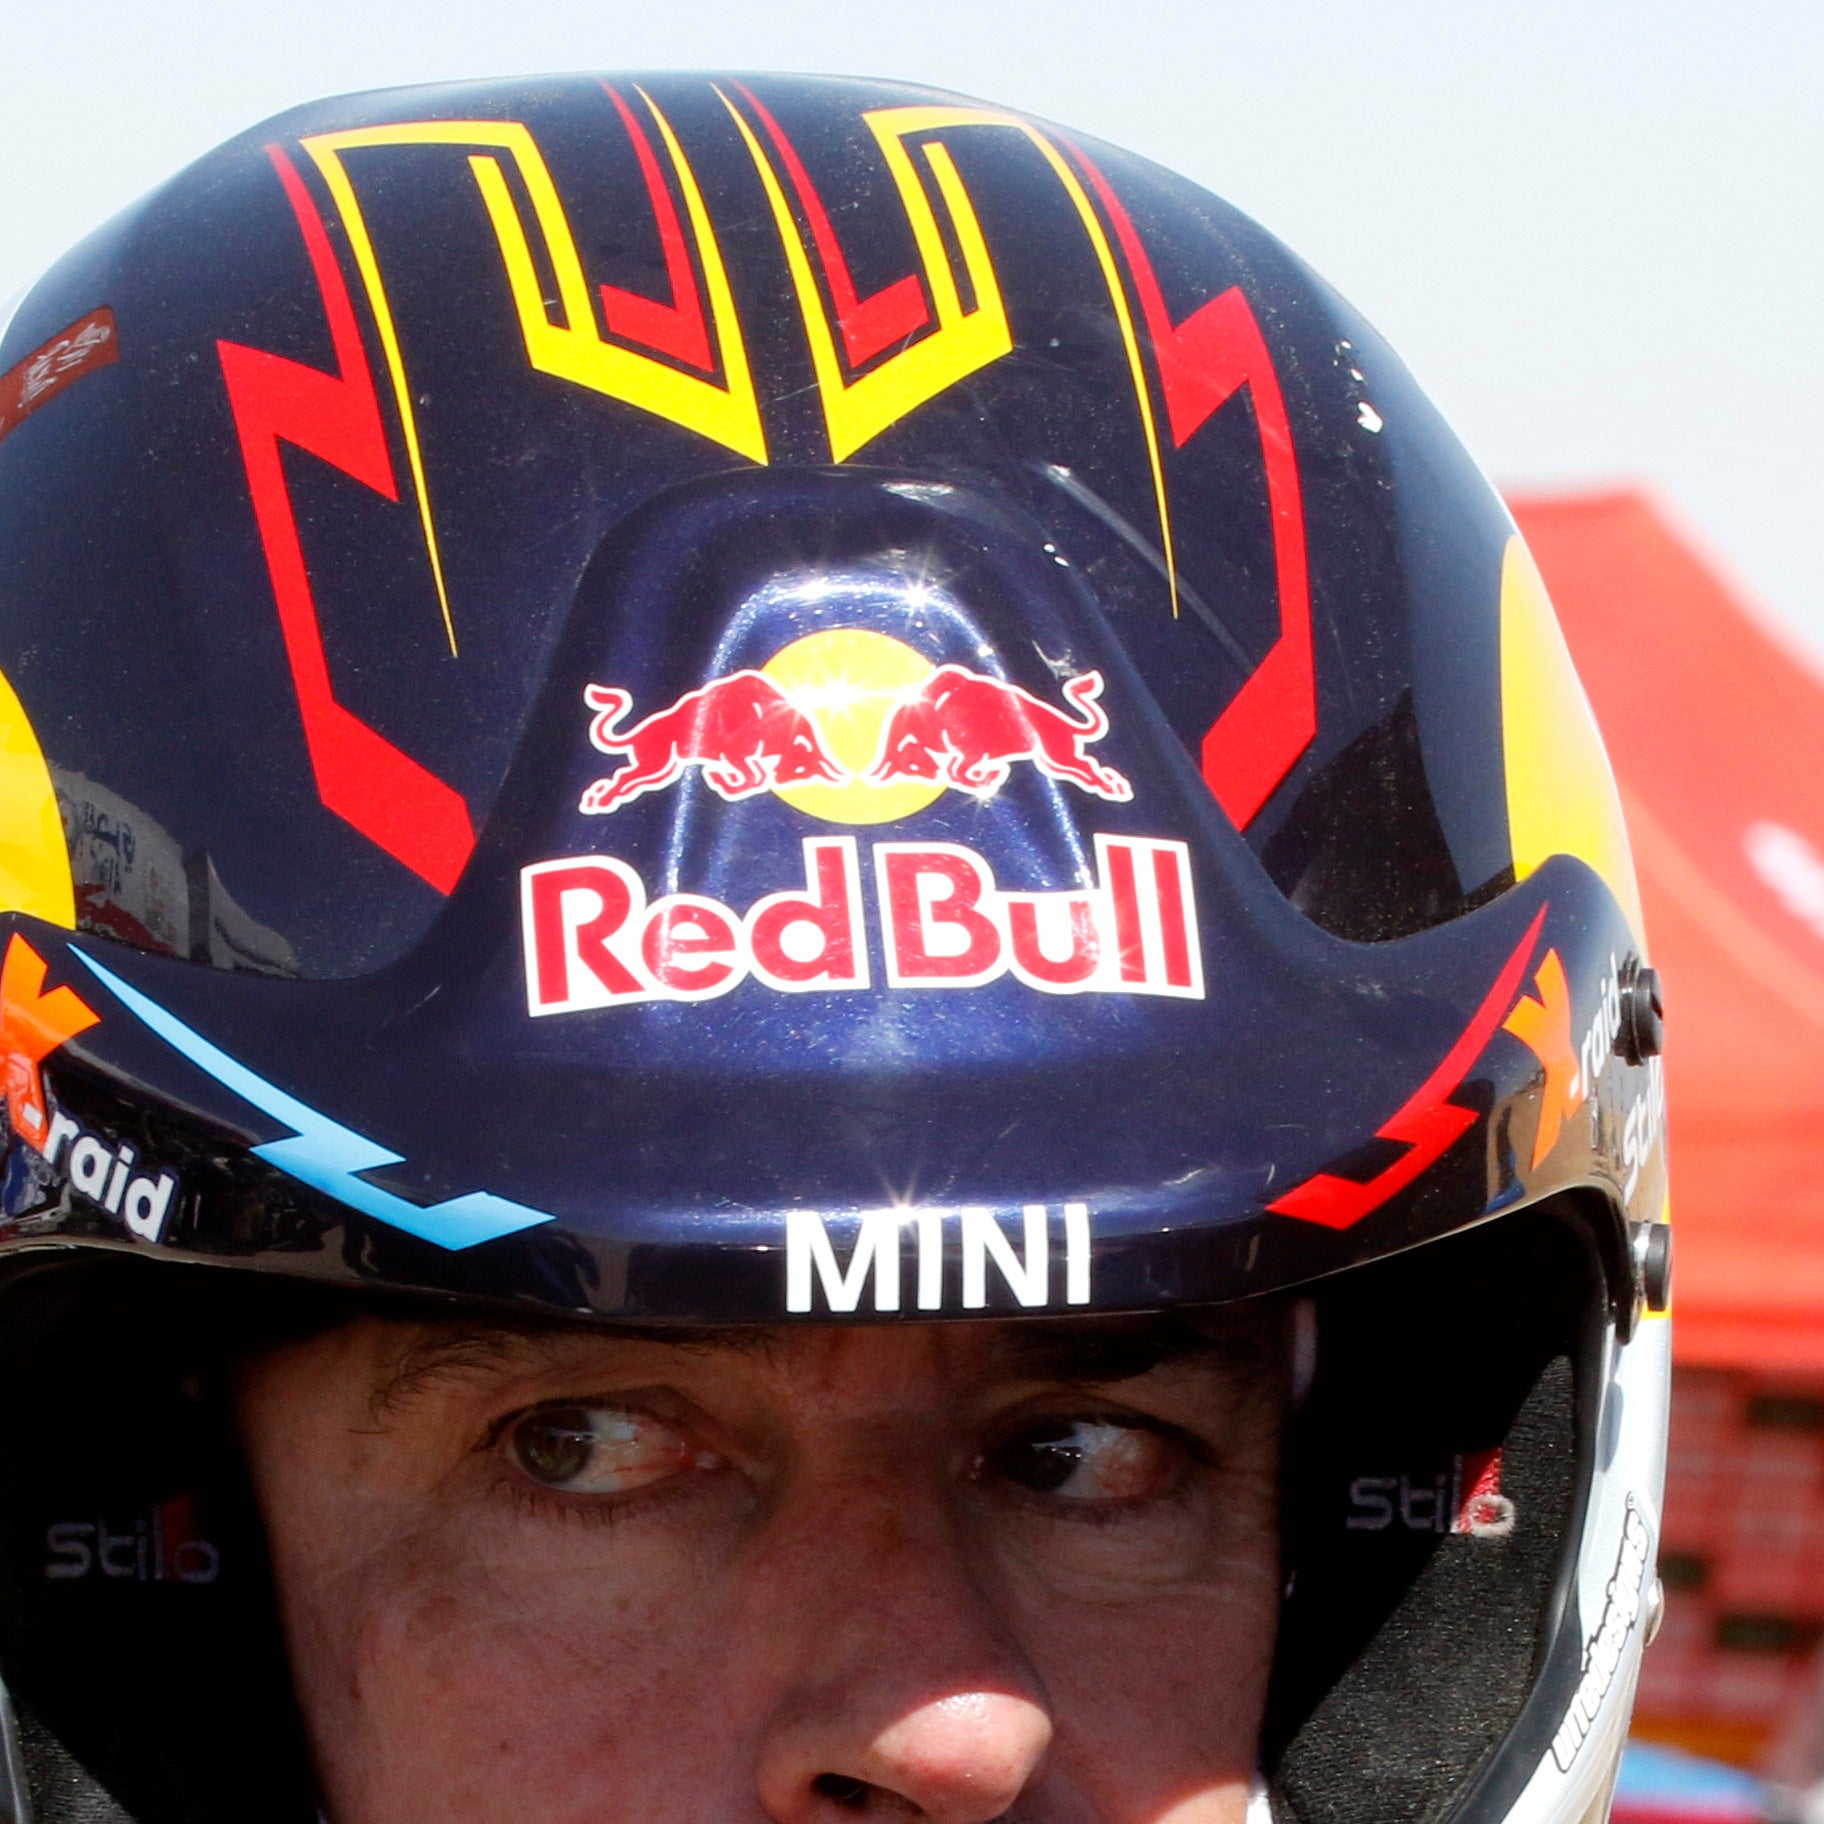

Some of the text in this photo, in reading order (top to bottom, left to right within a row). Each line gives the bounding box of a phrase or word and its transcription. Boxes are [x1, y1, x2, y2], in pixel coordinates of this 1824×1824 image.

[521, 833, 1205, 1017] Red Bull
[785, 1203, 1092, 1313] MINI
[44, 1500, 219, 1584] Stilo
[1345, 1447, 1516, 1538] Stilo
